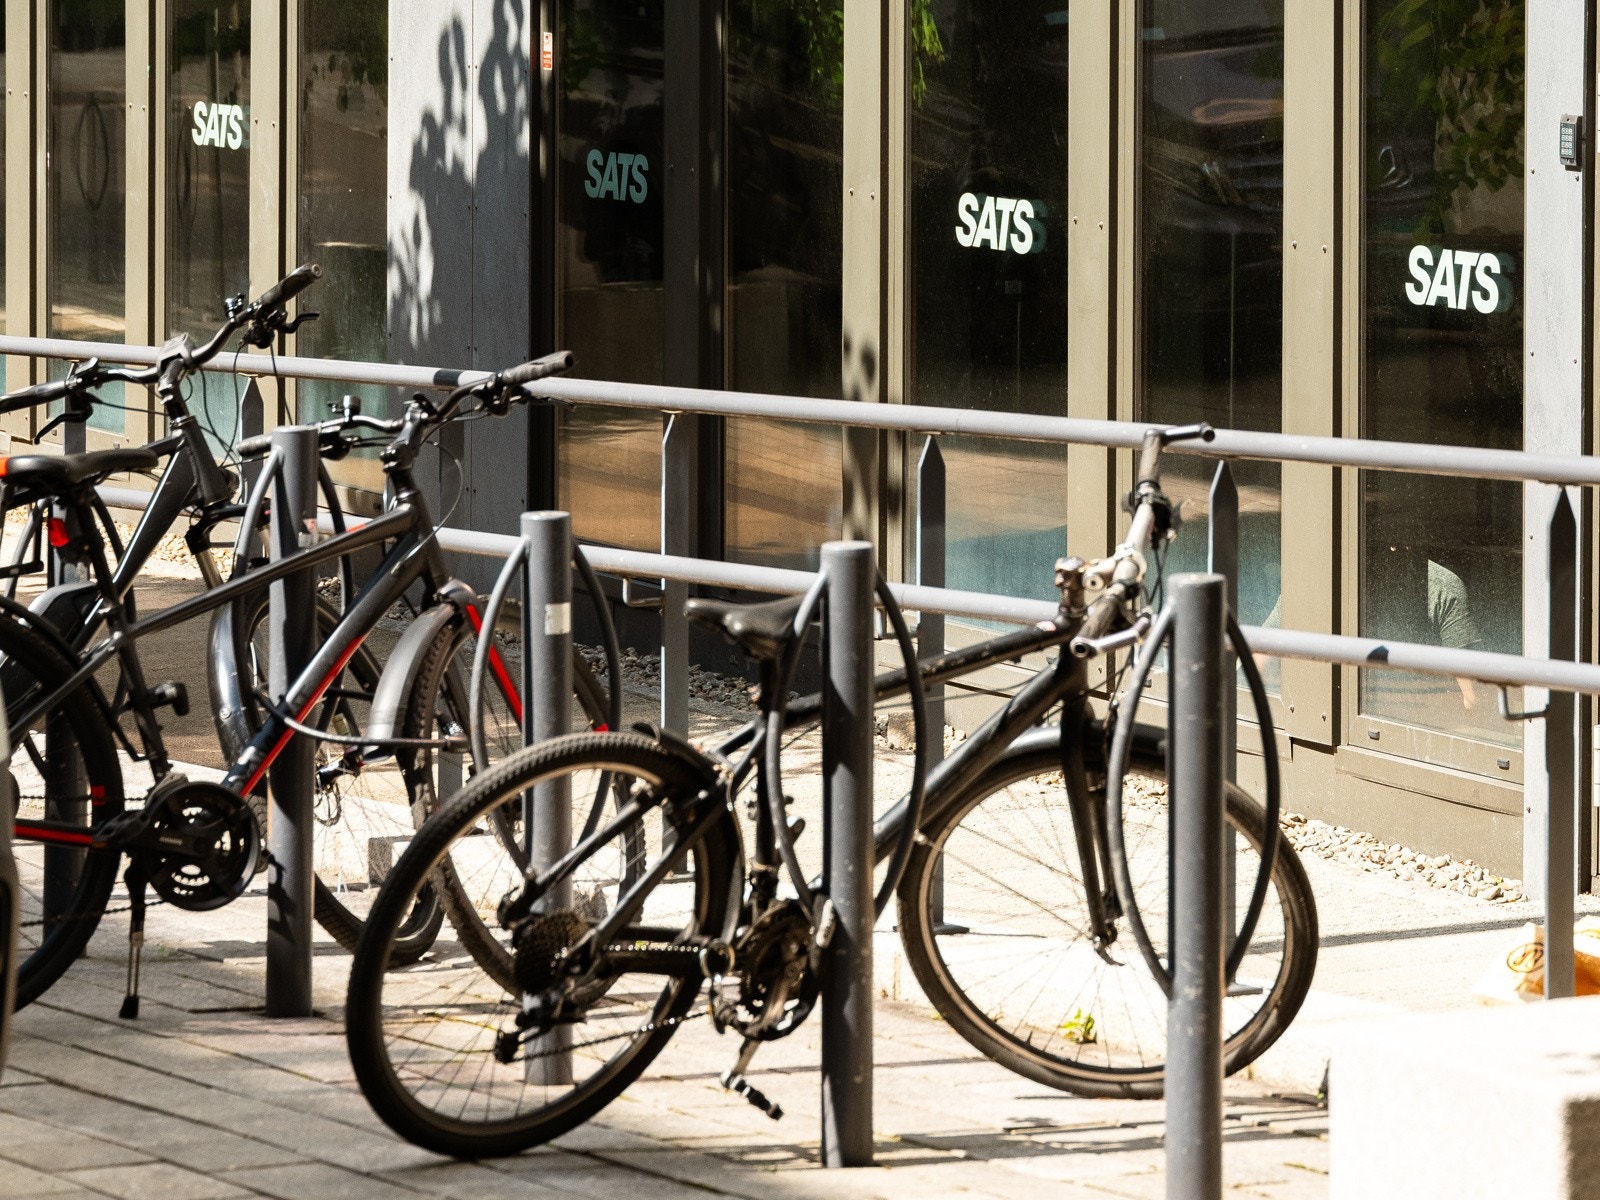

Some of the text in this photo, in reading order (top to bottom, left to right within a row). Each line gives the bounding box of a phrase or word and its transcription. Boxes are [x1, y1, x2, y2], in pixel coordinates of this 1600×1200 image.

[192, 101, 243, 150] SATS
[585, 150, 648, 204] SATS
[956, 193, 1034, 255] SATS
[1405, 245, 1500, 314] SATS
